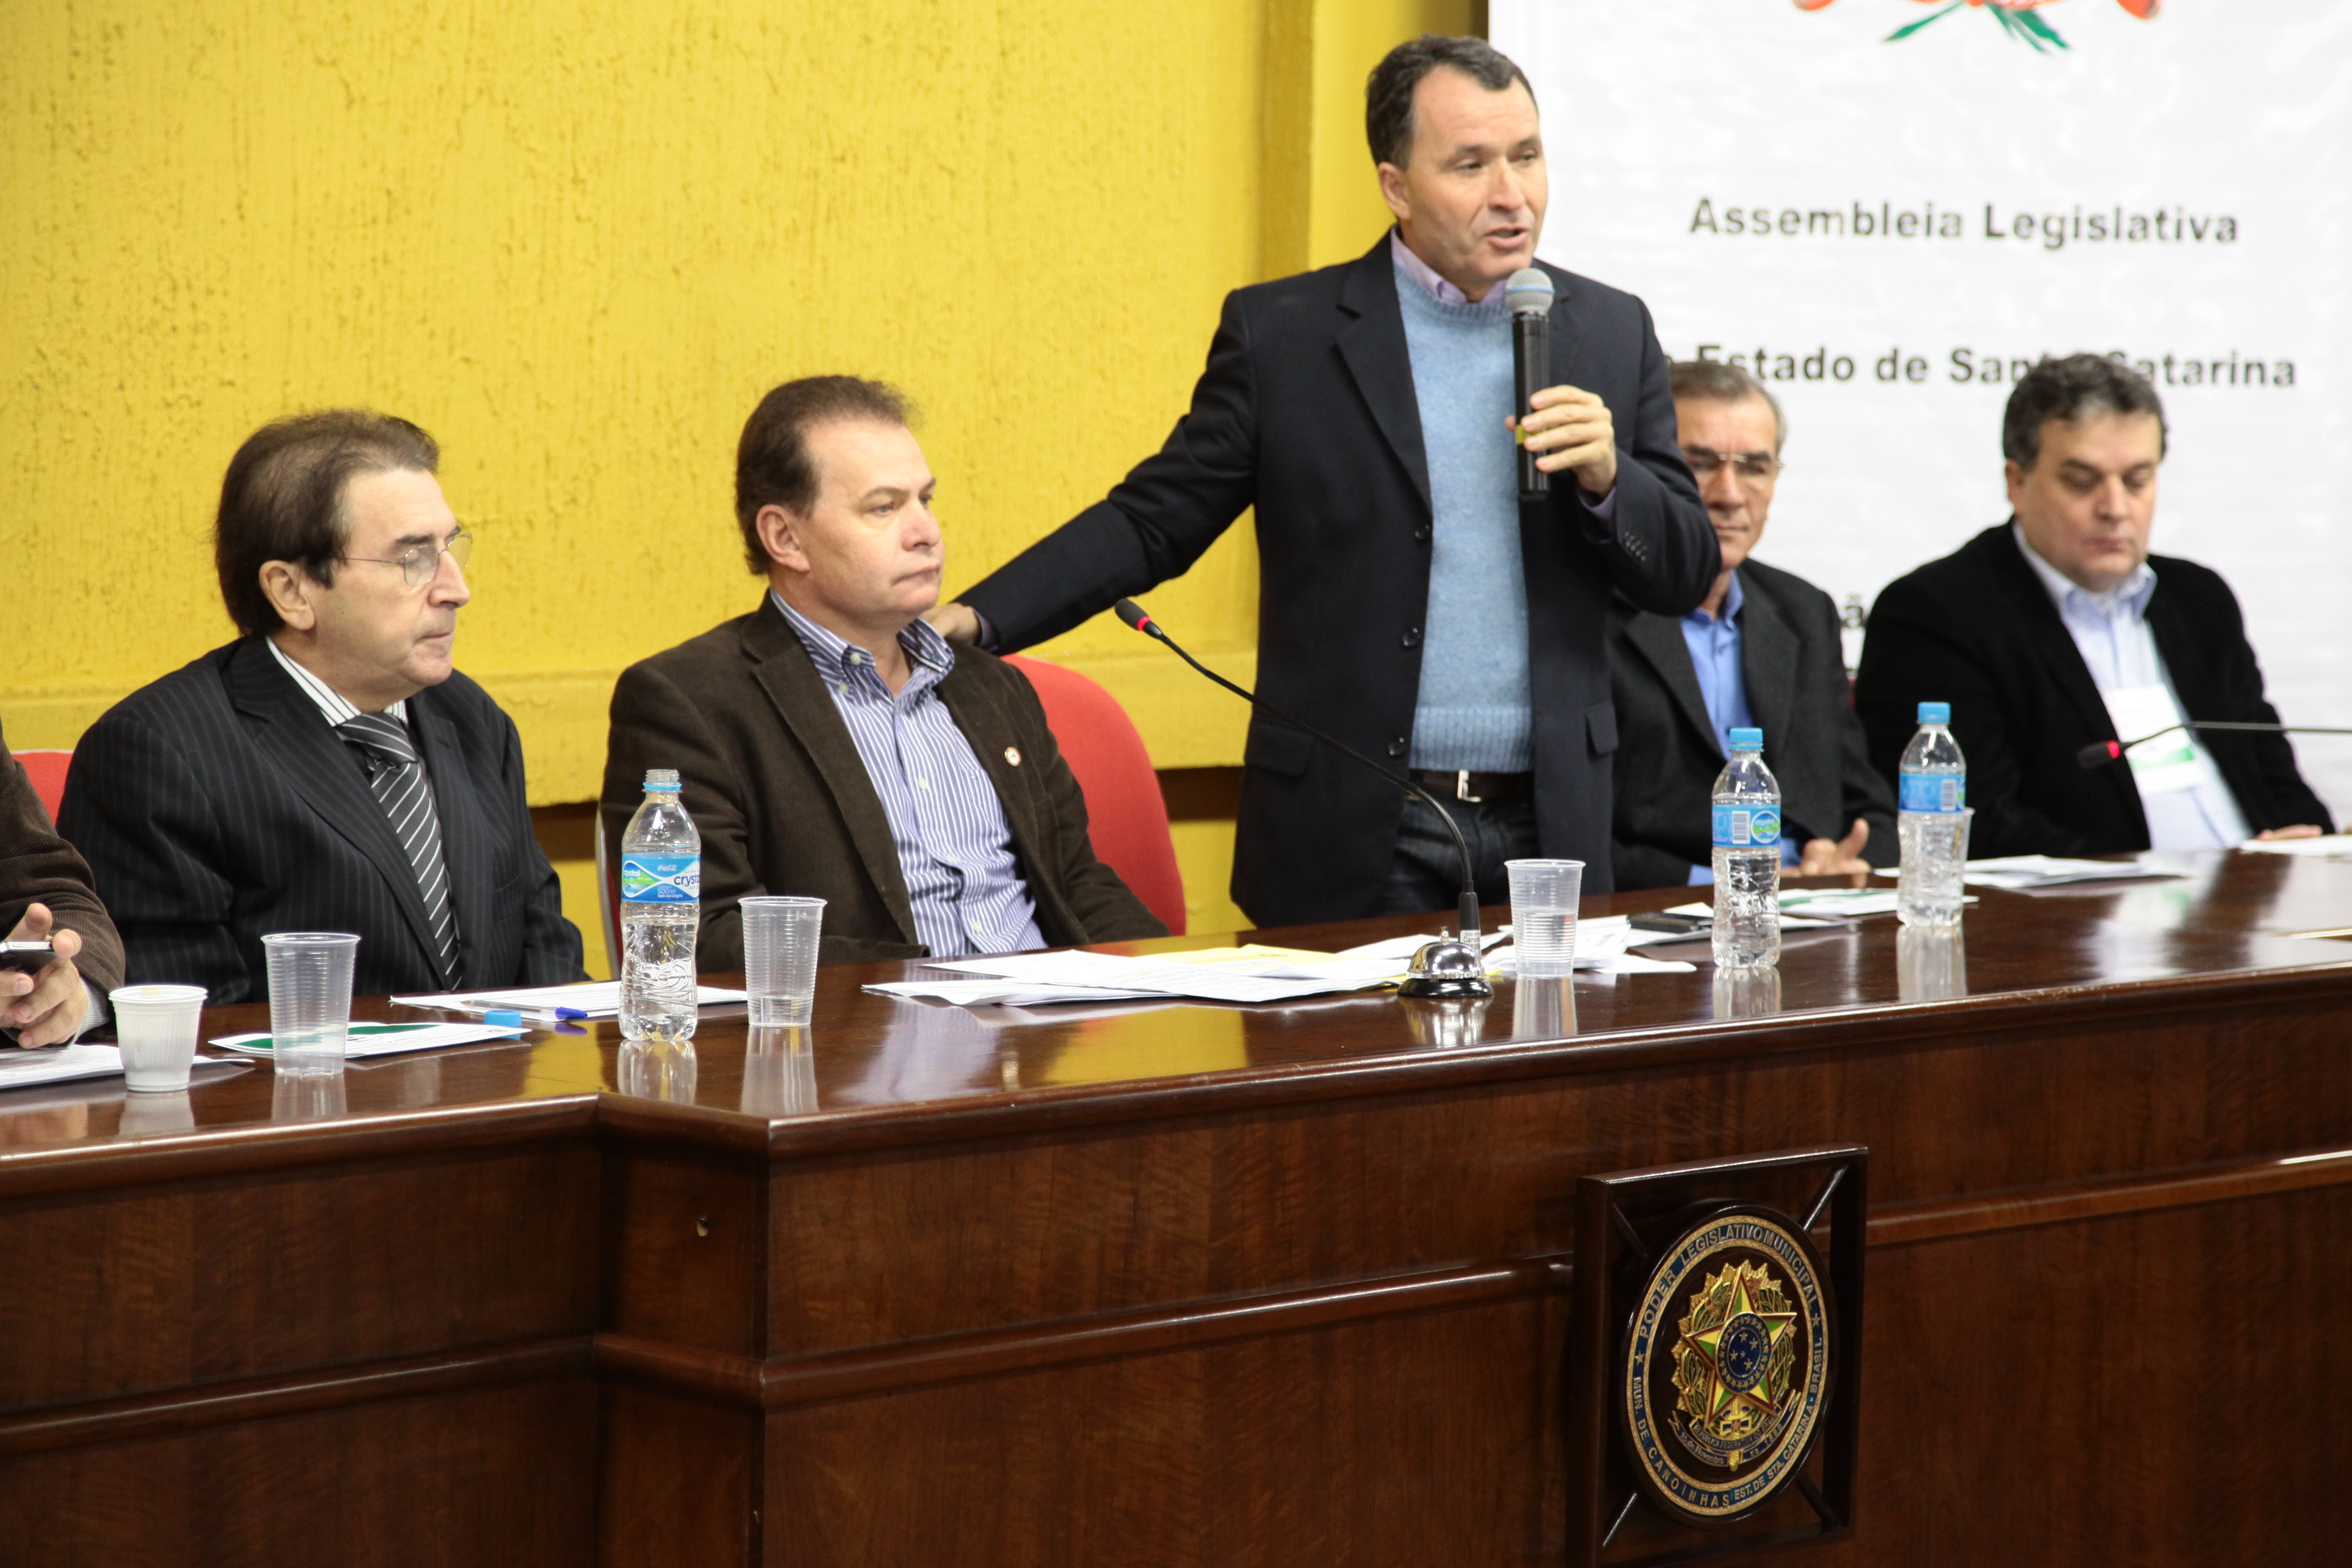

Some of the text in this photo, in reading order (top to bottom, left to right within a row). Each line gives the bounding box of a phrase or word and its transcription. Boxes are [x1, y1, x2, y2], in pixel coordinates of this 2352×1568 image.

[1689, 198, 2238, 250] Assembleia Legislativa
[1876, 347, 1928, 382] de
[1950, 348, 2048, 383] San
[674, 874, 700, 886] cryst
[1639, 1224, 1817, 1339] PODER LEGISLATIVO MUNICIPAL
[1810, 1337, 1822, 1394] BRASIL
[1633, 1376, 1643, 1414] MUN.
[1637, 1418, 1650, 1441] DE
[1783, 1404, 1816, 1460] CATARINA
[1648, 1447, 1729, 1506] CANOINHAS
[1752, 1477, 1766, 1493] DE
[1767, 1459, 1784, 1479] STA.
[1734, 1481, 1753, 1500] EST.
